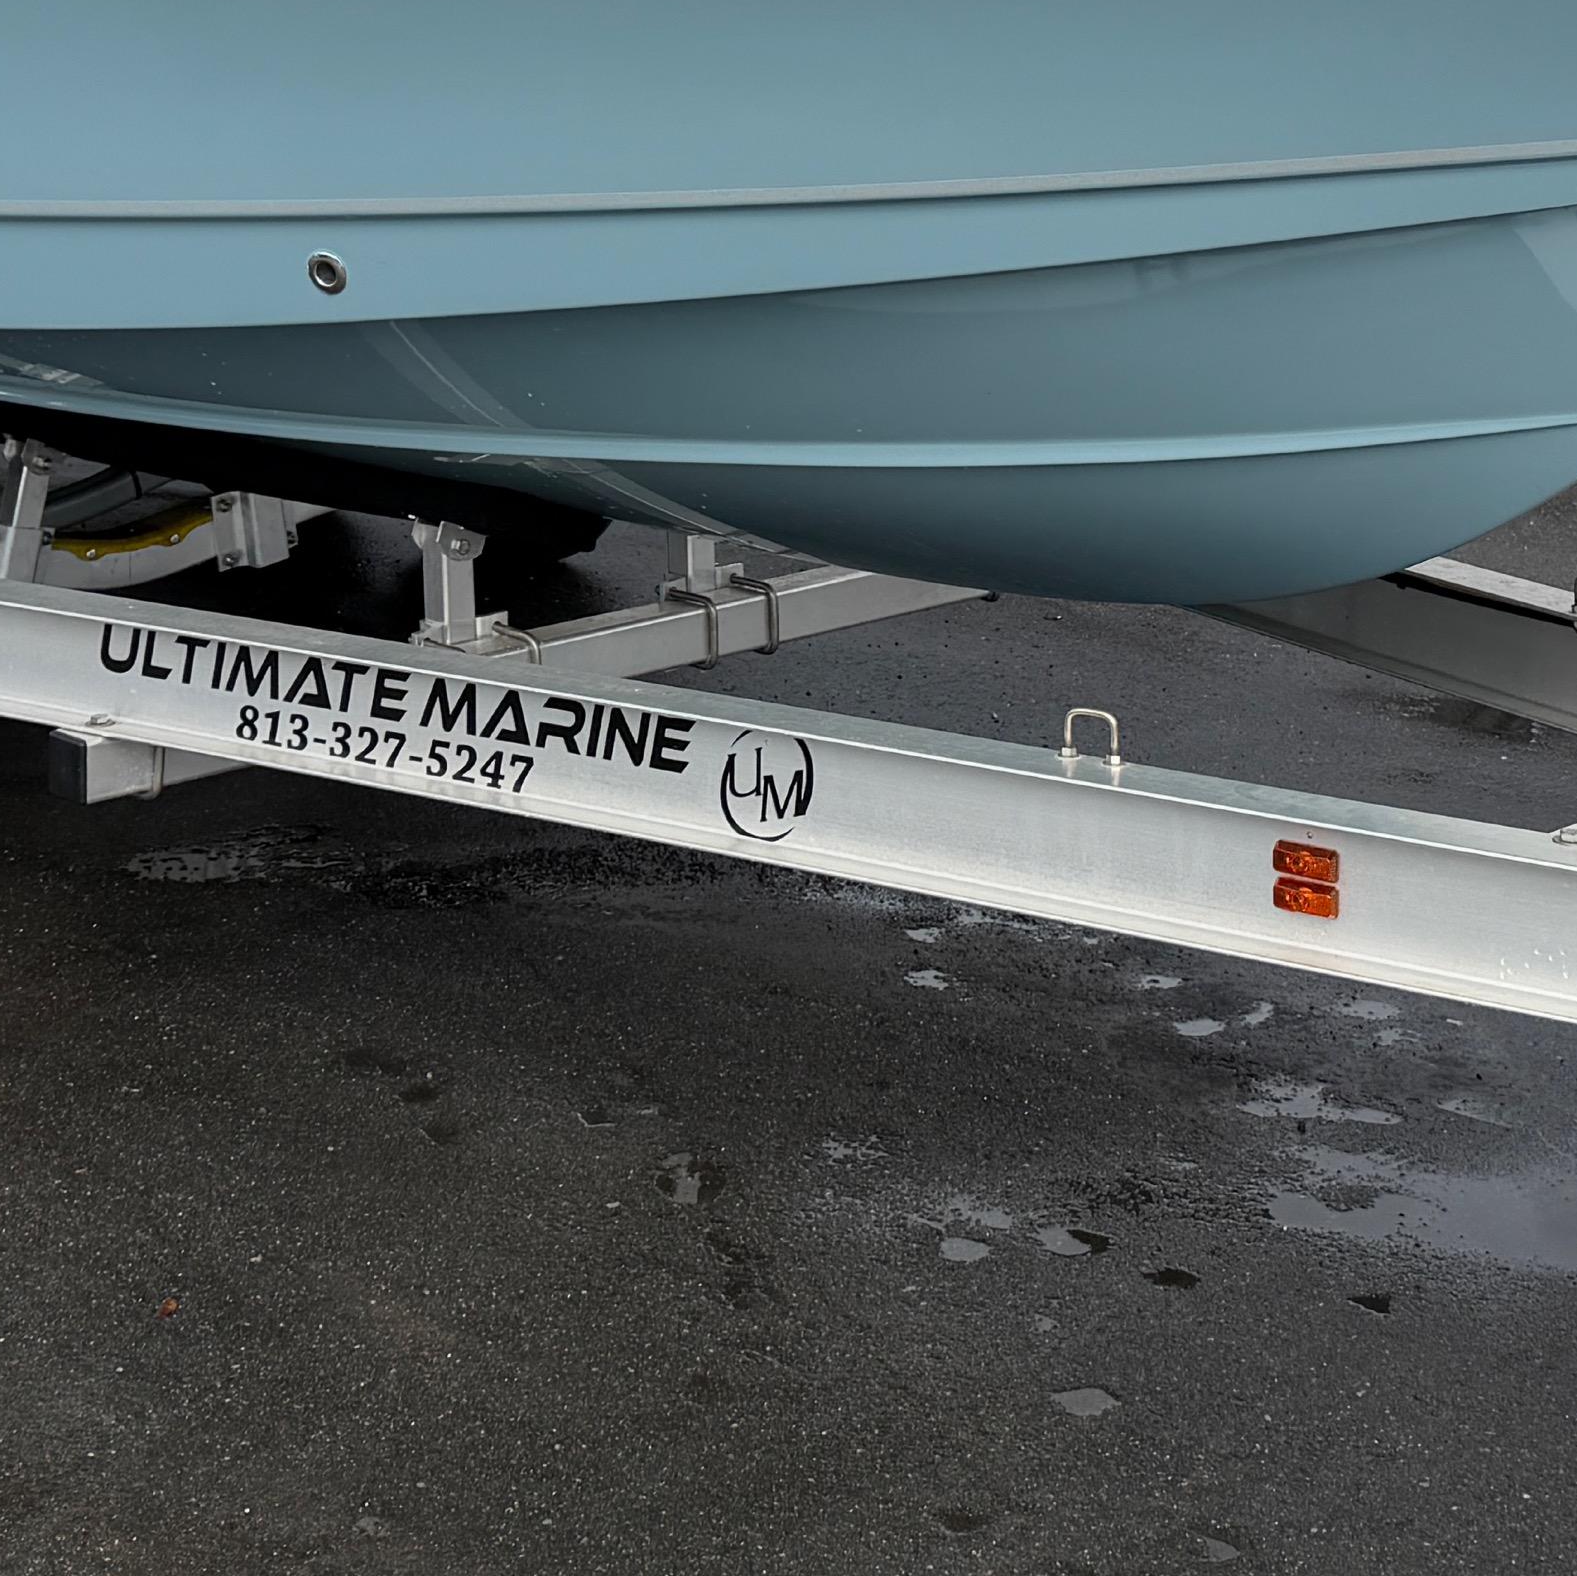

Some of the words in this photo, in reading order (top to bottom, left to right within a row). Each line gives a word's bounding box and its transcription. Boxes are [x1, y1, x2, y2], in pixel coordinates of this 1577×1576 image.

[99, 623, 413, 723] ULTIMATE
[418, 677, 697, 774] MARINE
[235, 704, 535, 794] 813-327-5247
